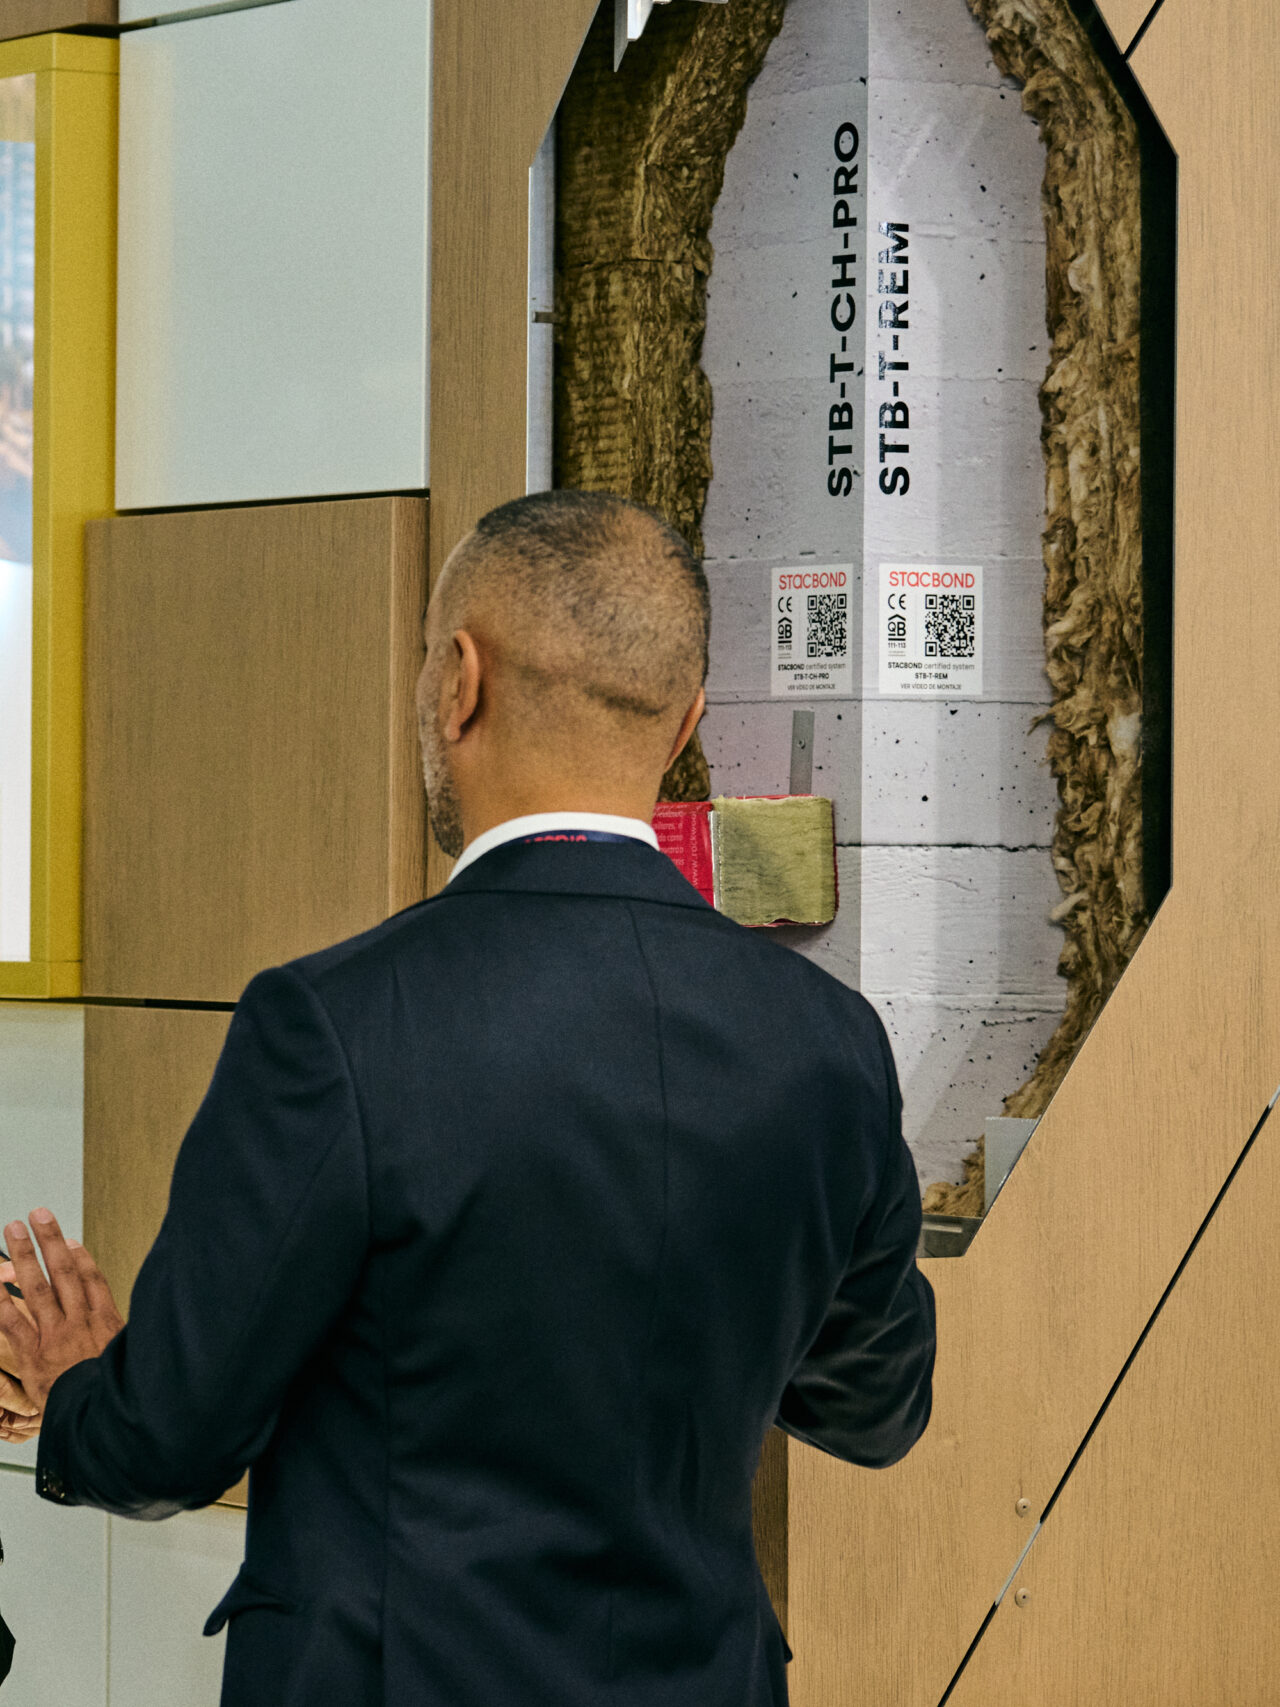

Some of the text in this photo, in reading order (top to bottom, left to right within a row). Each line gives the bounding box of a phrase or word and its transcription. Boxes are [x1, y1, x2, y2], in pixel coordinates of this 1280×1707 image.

[827, 121, 860, 497] STB-T-CH-PRO
[878, 221, 910, 496] STB-T-REM
[778, 662, 846, 672] STACBOND certified system
[924, 662, 951, 670] certified
[952, 663, 975, 671] system
